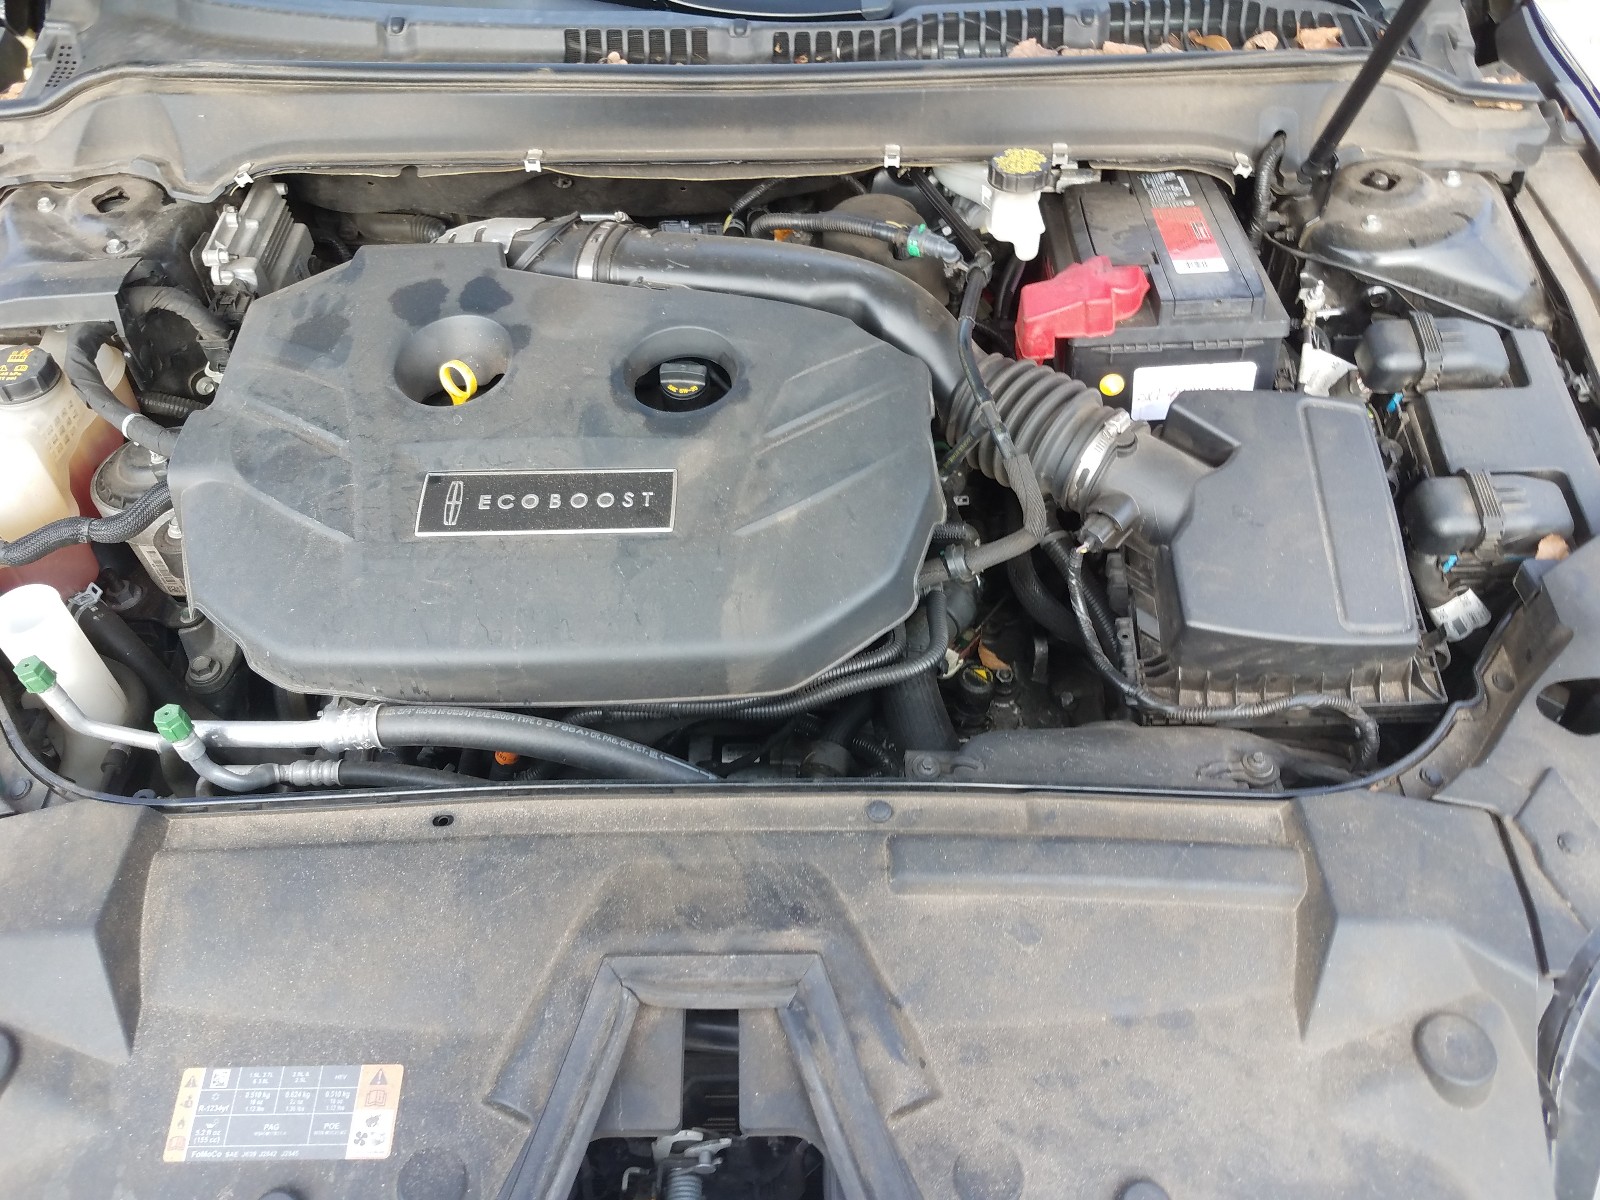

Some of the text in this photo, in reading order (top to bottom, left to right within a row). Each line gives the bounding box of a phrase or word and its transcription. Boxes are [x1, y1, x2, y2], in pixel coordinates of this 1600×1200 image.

[478, 491, 655, 510] ECOBOOST
[198, 1104, 230, 1114] R-1234yf
[263, 1123, 280, 1131] PAG
[323, 1122, 340, 1130] POE
[191, 1150, 222, 1158] FoMoCo
[225, 1150, 239, 1158] SAE
